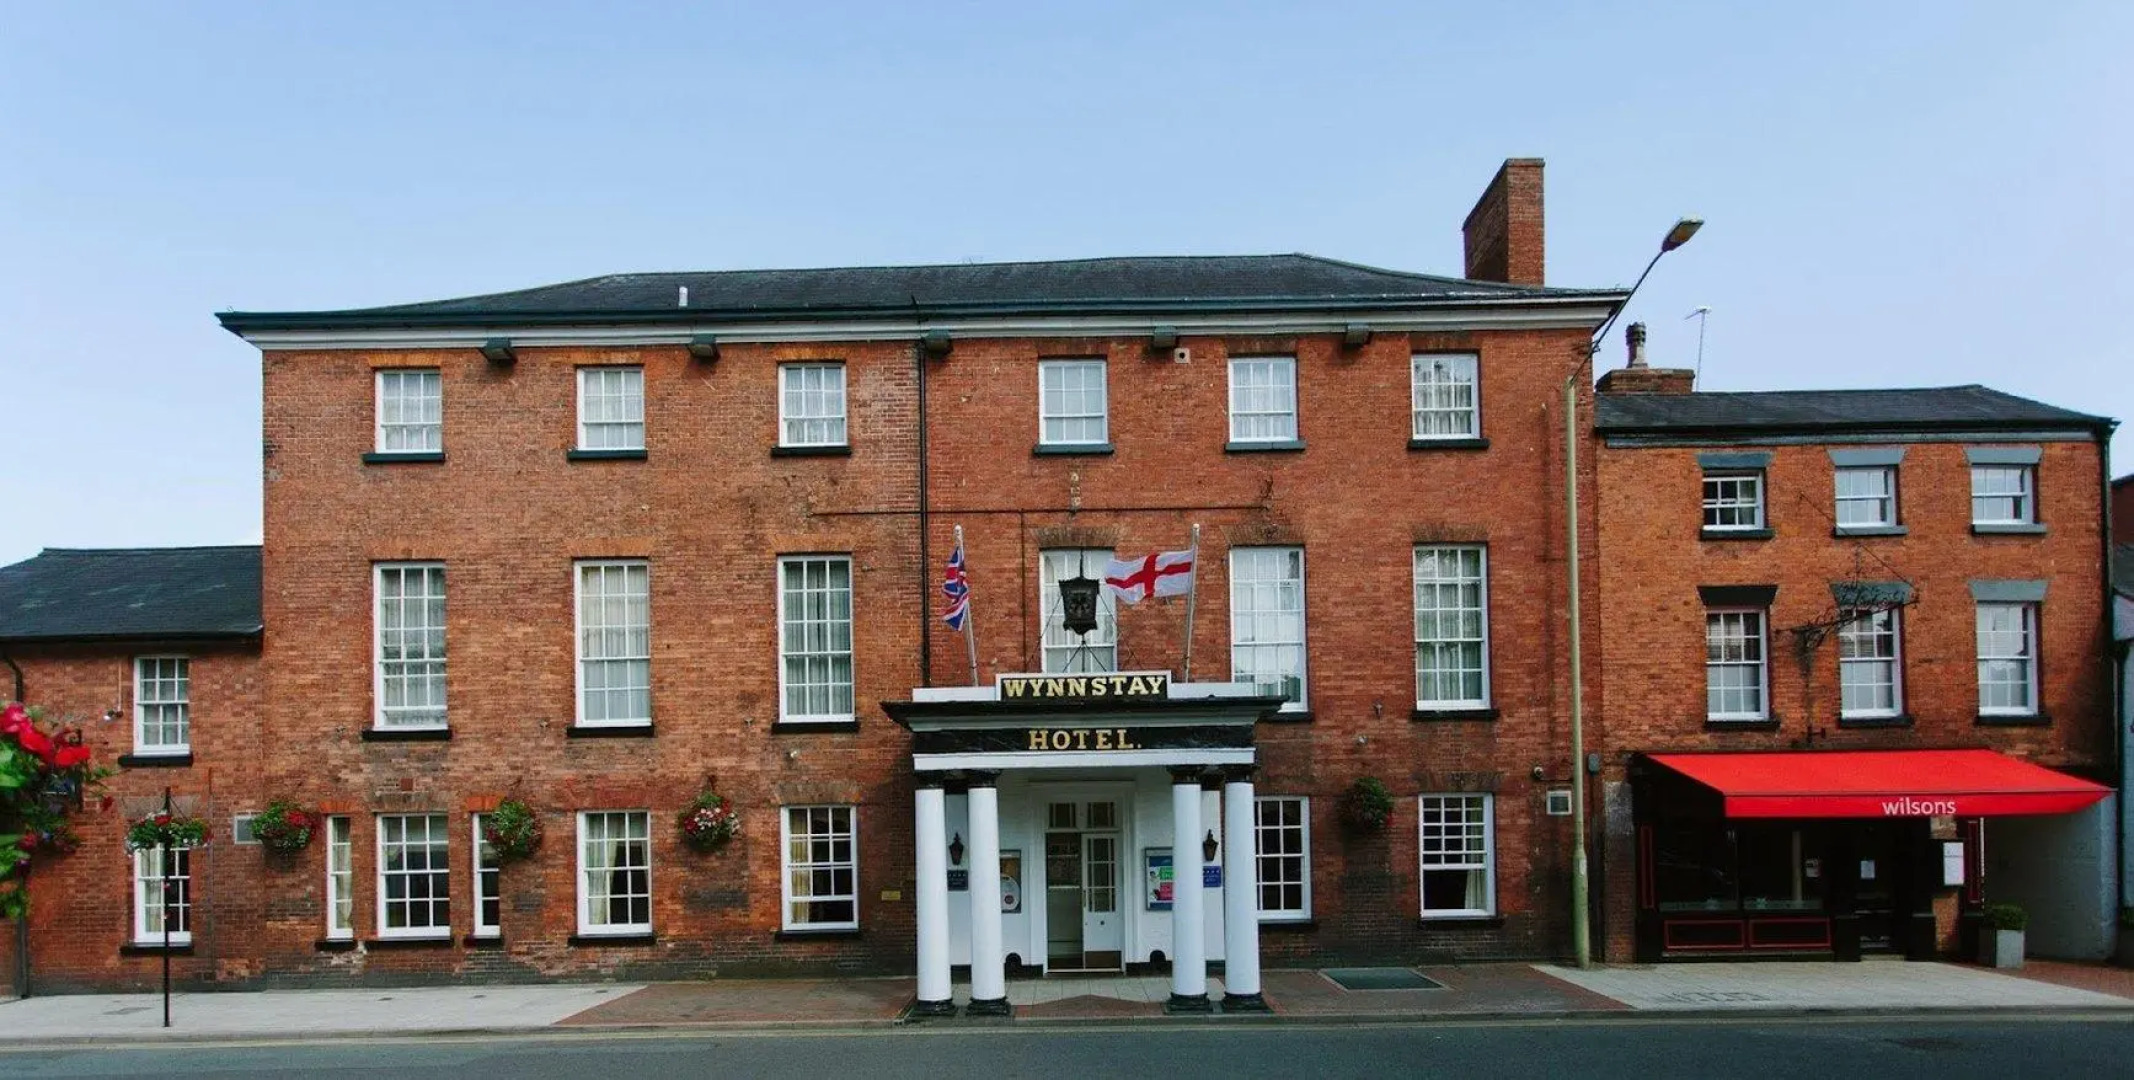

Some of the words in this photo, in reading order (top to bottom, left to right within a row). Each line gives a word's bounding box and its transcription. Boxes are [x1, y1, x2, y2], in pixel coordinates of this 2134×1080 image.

[1003, 676, 1165, 697] WYNNSTAY
[1028, 729, 1142, 749] HOTEL.
[1882, 796, 1957, 815] wilsons
